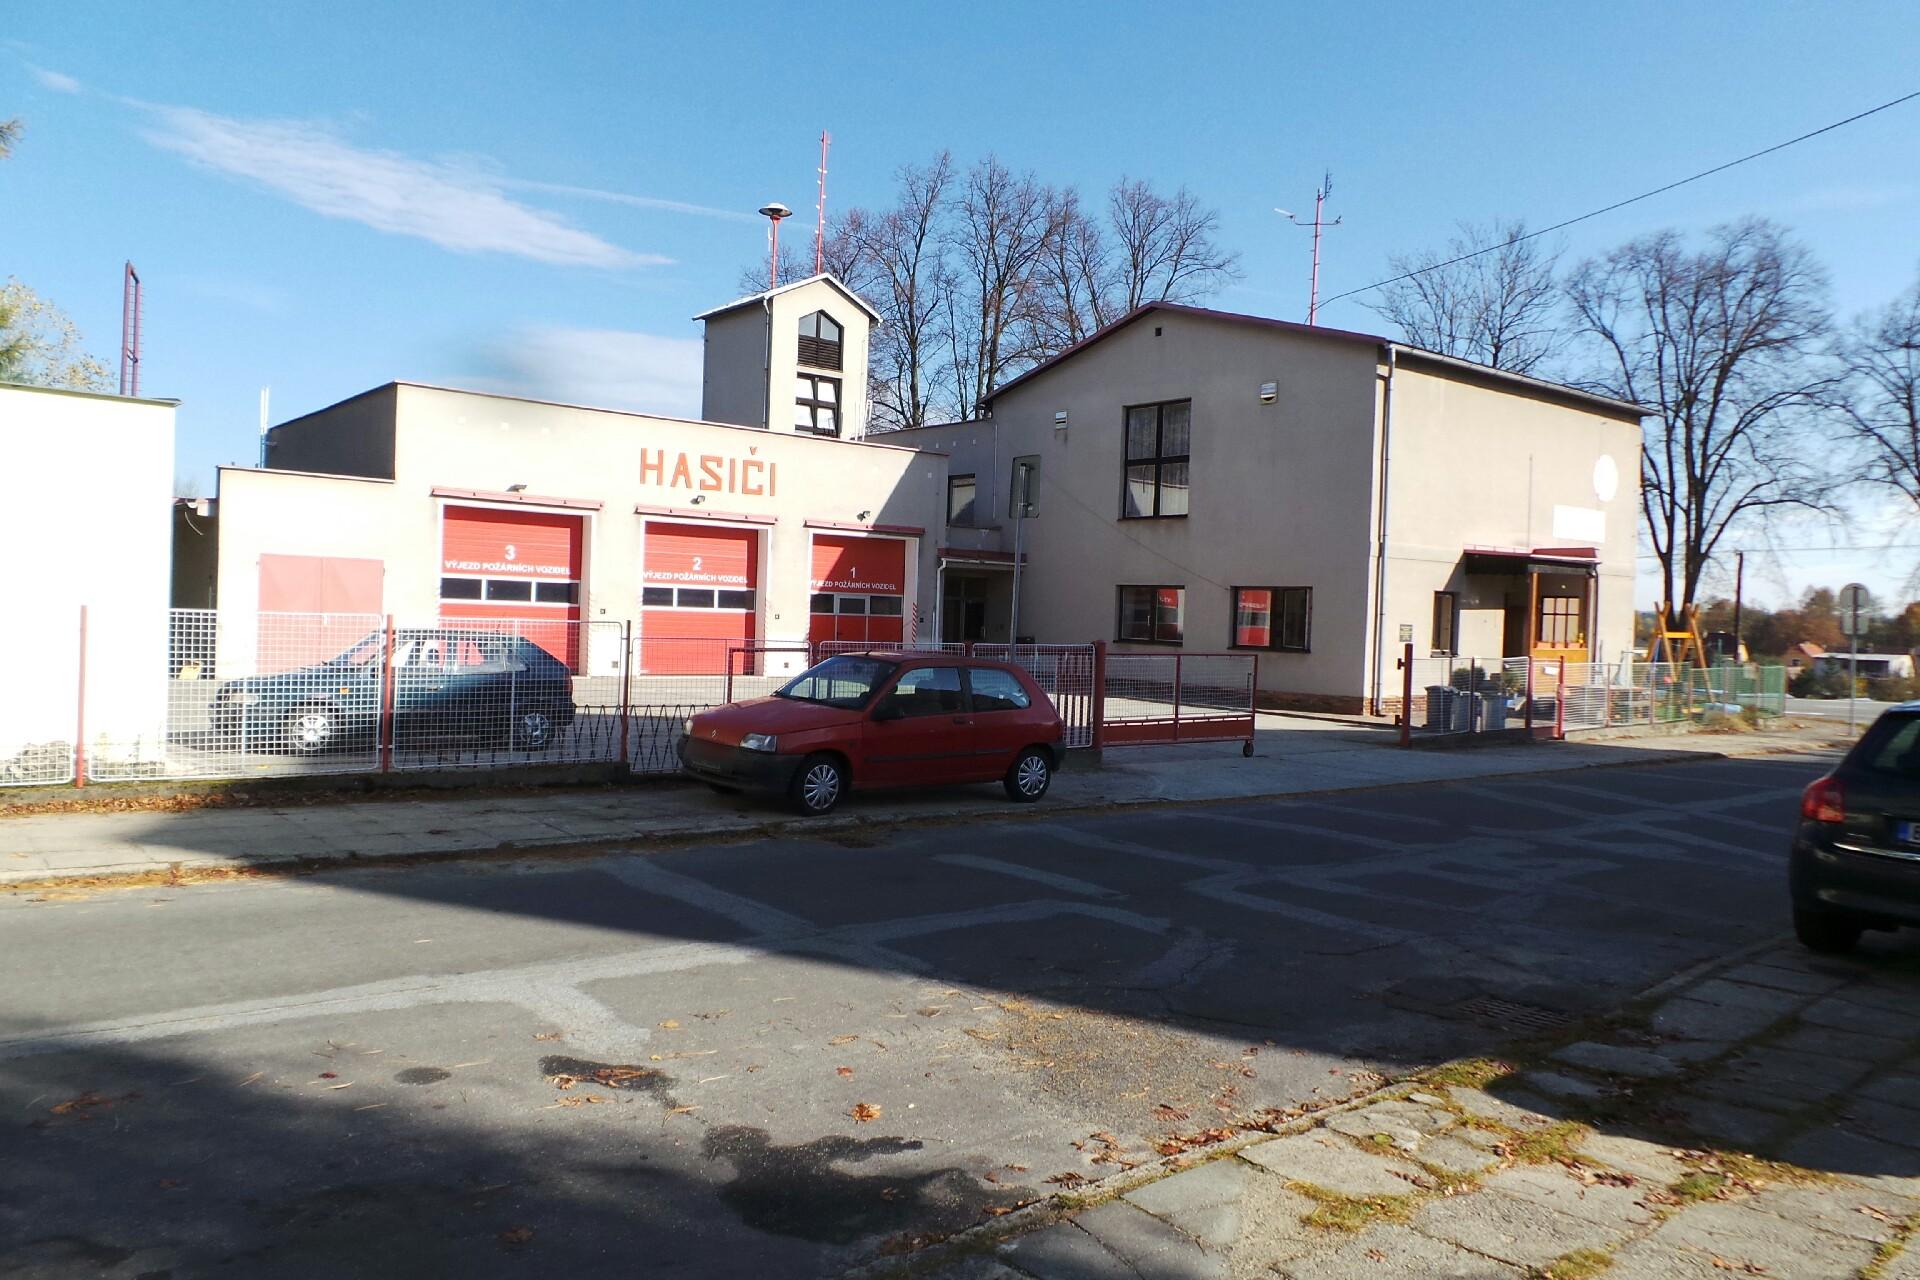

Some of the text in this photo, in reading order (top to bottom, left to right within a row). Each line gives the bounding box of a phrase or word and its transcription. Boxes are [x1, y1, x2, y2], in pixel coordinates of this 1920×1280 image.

[639, 446, 776, 497] HASIČI
[504, 545, 516, 560] 3
[445, 560, 570, 575] VÝJEZD POŽÁRNÍCH VOZIDEL
[692, 556, 703, 571] 2
[674, 571, 716, 582] POŽÁRNÍCH
[718, 575, 748, 584] VOZIDEL
[850, 567, 856, 578] 1
[835, 580, 870, 589] POŽÁRNÍCH
